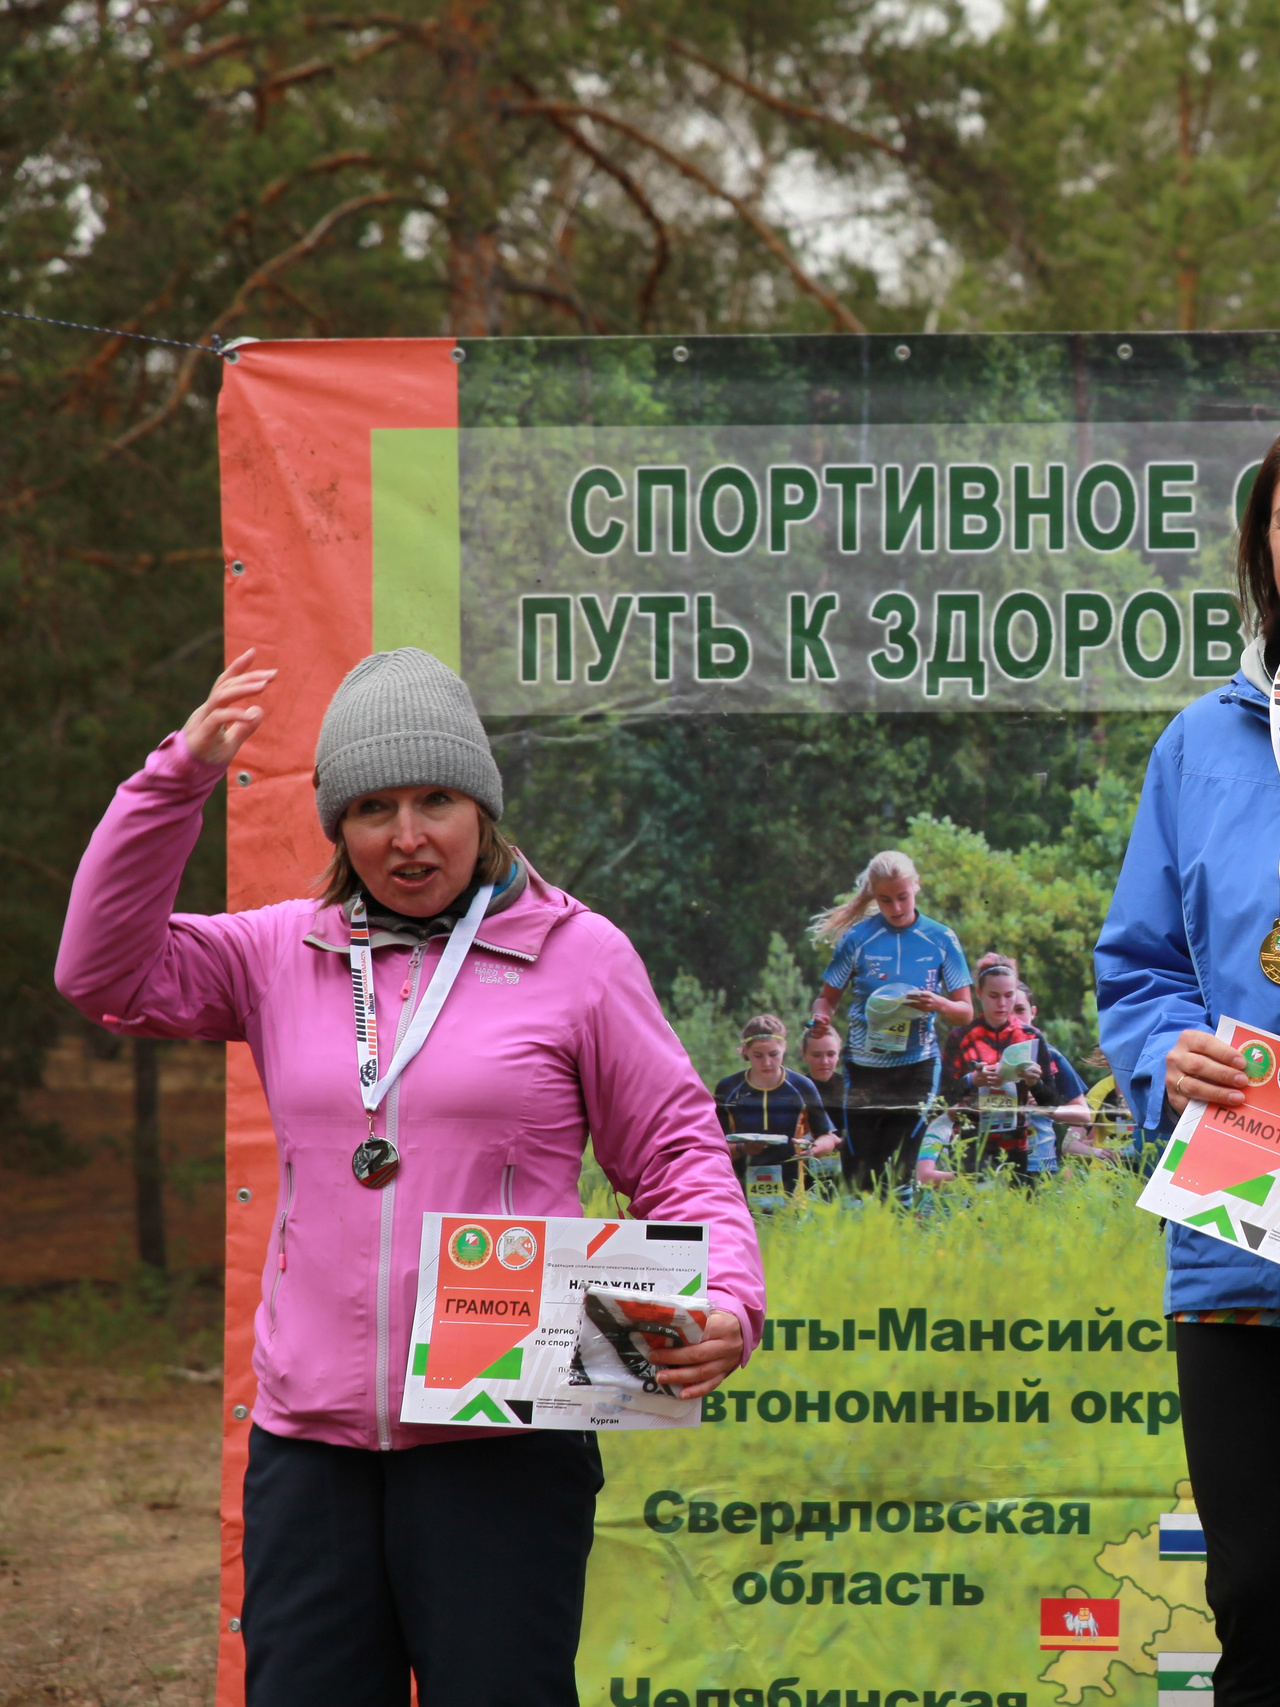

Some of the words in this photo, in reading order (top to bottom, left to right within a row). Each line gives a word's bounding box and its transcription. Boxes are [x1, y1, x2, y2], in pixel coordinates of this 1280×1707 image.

[570, 460, 1200, 556] СПОРТИВНОЕ
[518, 592, 751, 684] ПУТЬ
[788, 591, 840, 682] К
[870, 588, 1254, 700] ЗДОРОВ
[474, 960, 525, 973] MOUNTAIN
[474, 966, 499, 977] HARD
[478, 974, 504, 985] WEAR
[445, 1298, 532, 1317] ГРАМОТА
[535, 1338, 546, 1346] по
[762, 1307, 1177, 1353] ты-Мансийс
[590, 1417, 619, 1425] Курган
[701, 1378, 1050, 1424] втономный
[1070, 1389, 1181, 1436] окр
[643, 1489, 1092, 1545] Свердловская
[732, 1560, 985, 1606] область
